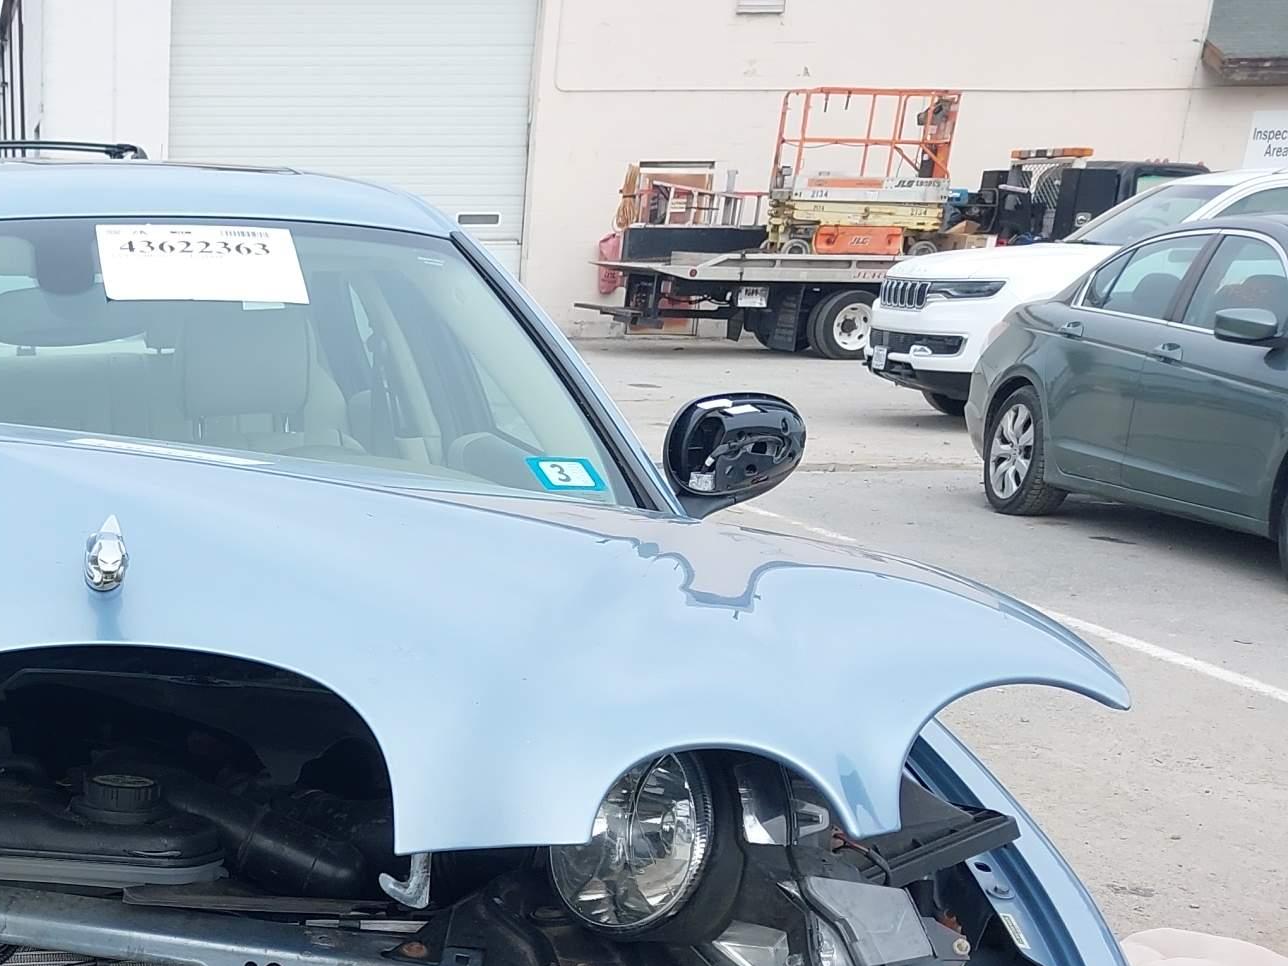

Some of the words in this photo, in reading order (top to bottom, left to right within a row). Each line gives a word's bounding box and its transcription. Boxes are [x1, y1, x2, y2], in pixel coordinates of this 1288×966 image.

[1253, 128, 1288, 143] Inspec
[1264, 144, 1288, 157] Area
[895, 180, 916, 188] JLG
[850, 236, 869, 245] JLG
[119, 240, 270, 256] 43622363
[550, 464, 571, 482] 3
